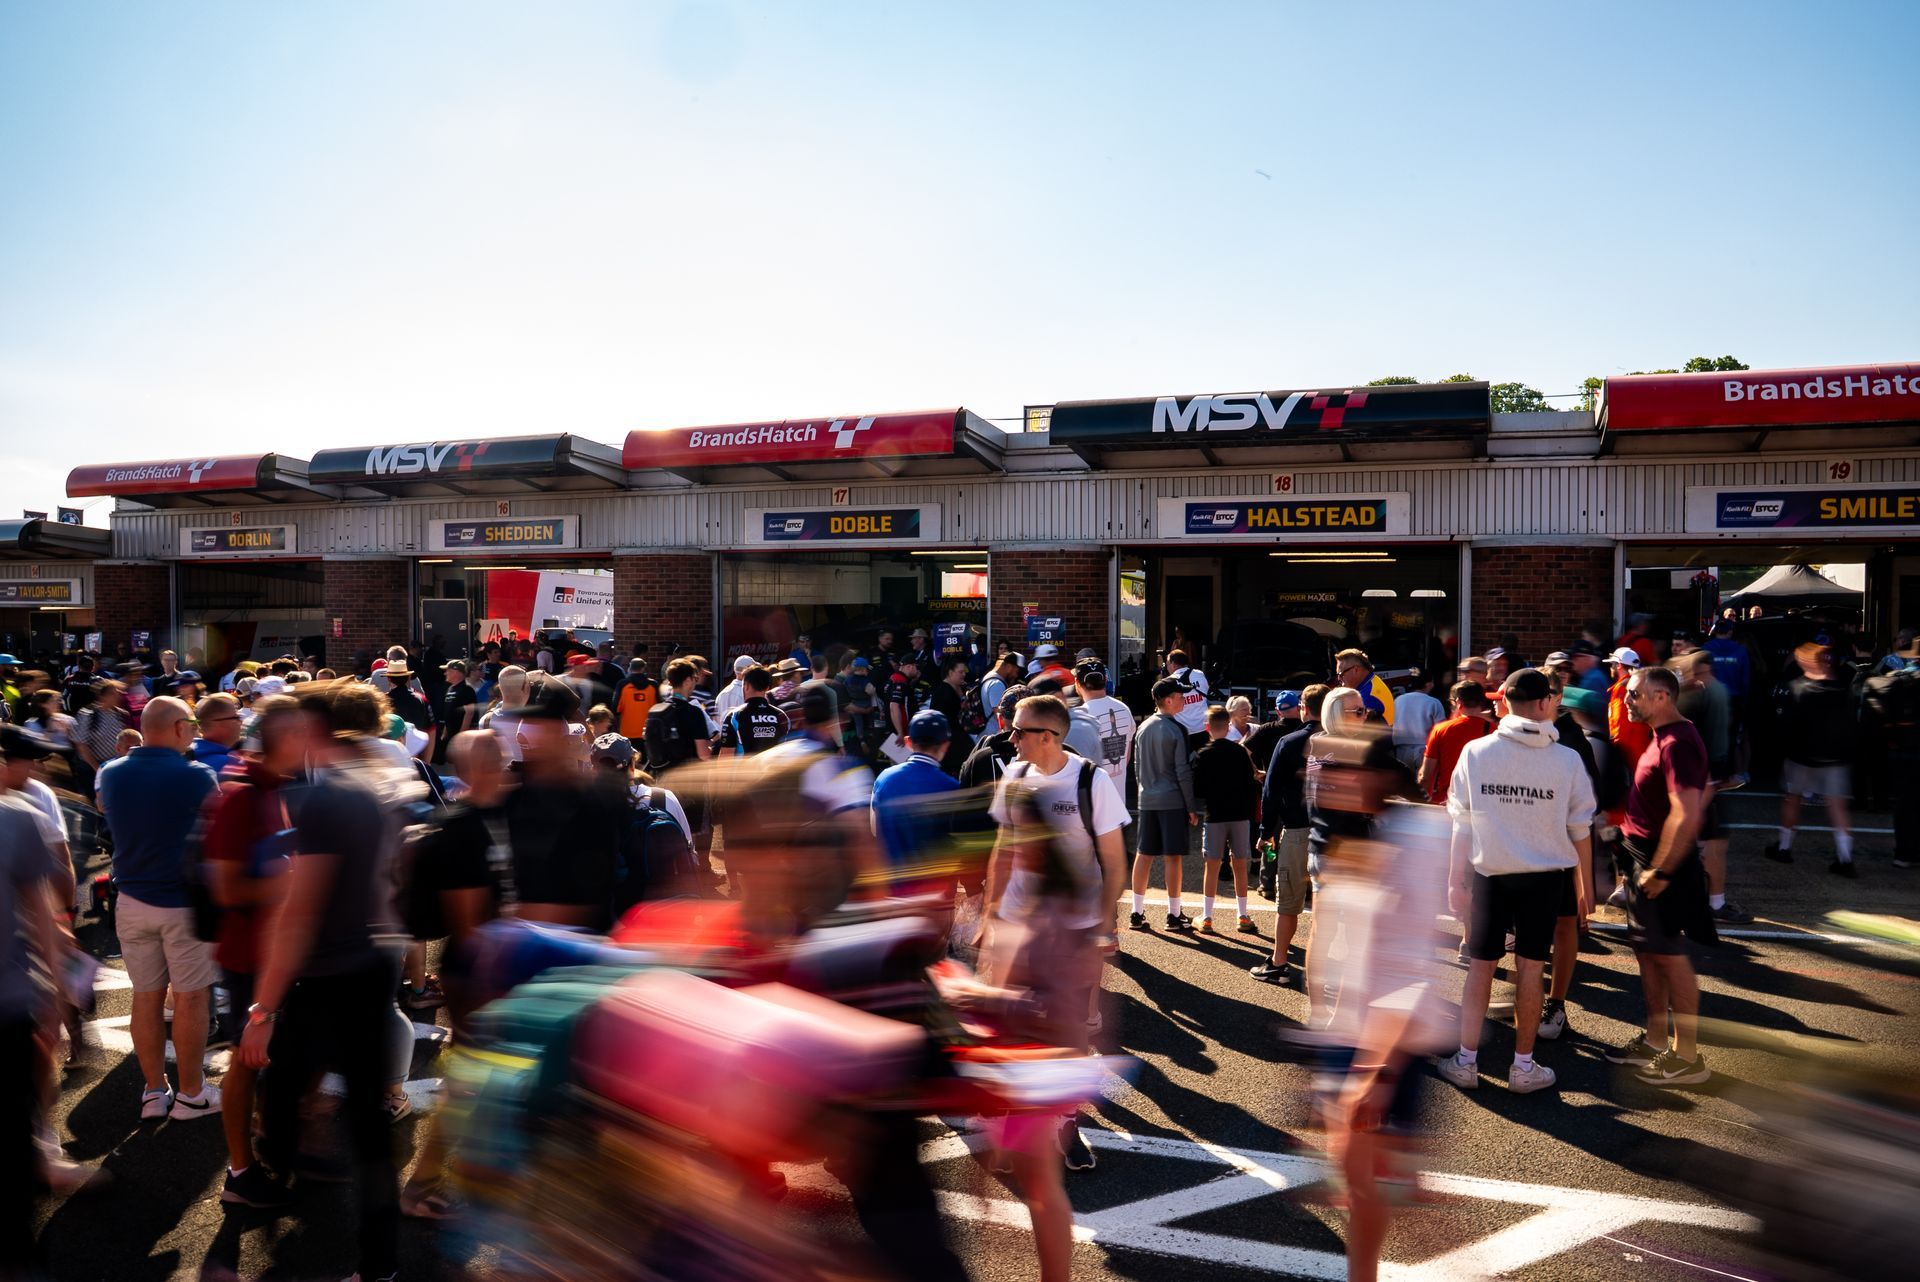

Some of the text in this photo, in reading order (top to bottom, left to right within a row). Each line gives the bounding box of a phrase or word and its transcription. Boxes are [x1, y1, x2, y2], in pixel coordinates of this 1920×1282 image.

[1152, 392, 1306, 433] MSV
[689, 424, 817, 448] BrandsHatch
[365, 442, 456, 475] MSV
[105, 464, 181, 482] BrandsHatch
[1829, 462, 1850, 479] 19
[1274, 475, 1291, 491] 18
[834, 489, 847, 503] 17
[499, 502, 509, 515] 16
[232, 513, 240, 525] 15
[1247, 506, 1376, 527] HALSTEAD
[830, 516, 892, 534] DOBLE
[229, 533, 271, 547] DORLIN
[485, 525, 553, 541] SHEDDEN
[19, 586, 69, 598] TAYLOR-SMITH
[554, 592, 574, 604] GR
[1279, 592, 1336, 602] POWER MAXED
[576, 597, 602, 606] United
[929, 601, 960, 609] POWER
[946, 637, 958, 645] 88
[1039, 631, 1052, 639] 50
[751, 715, 778, 723] LKQ
[1481, 784, 1554, 800] ESSENTIALS
